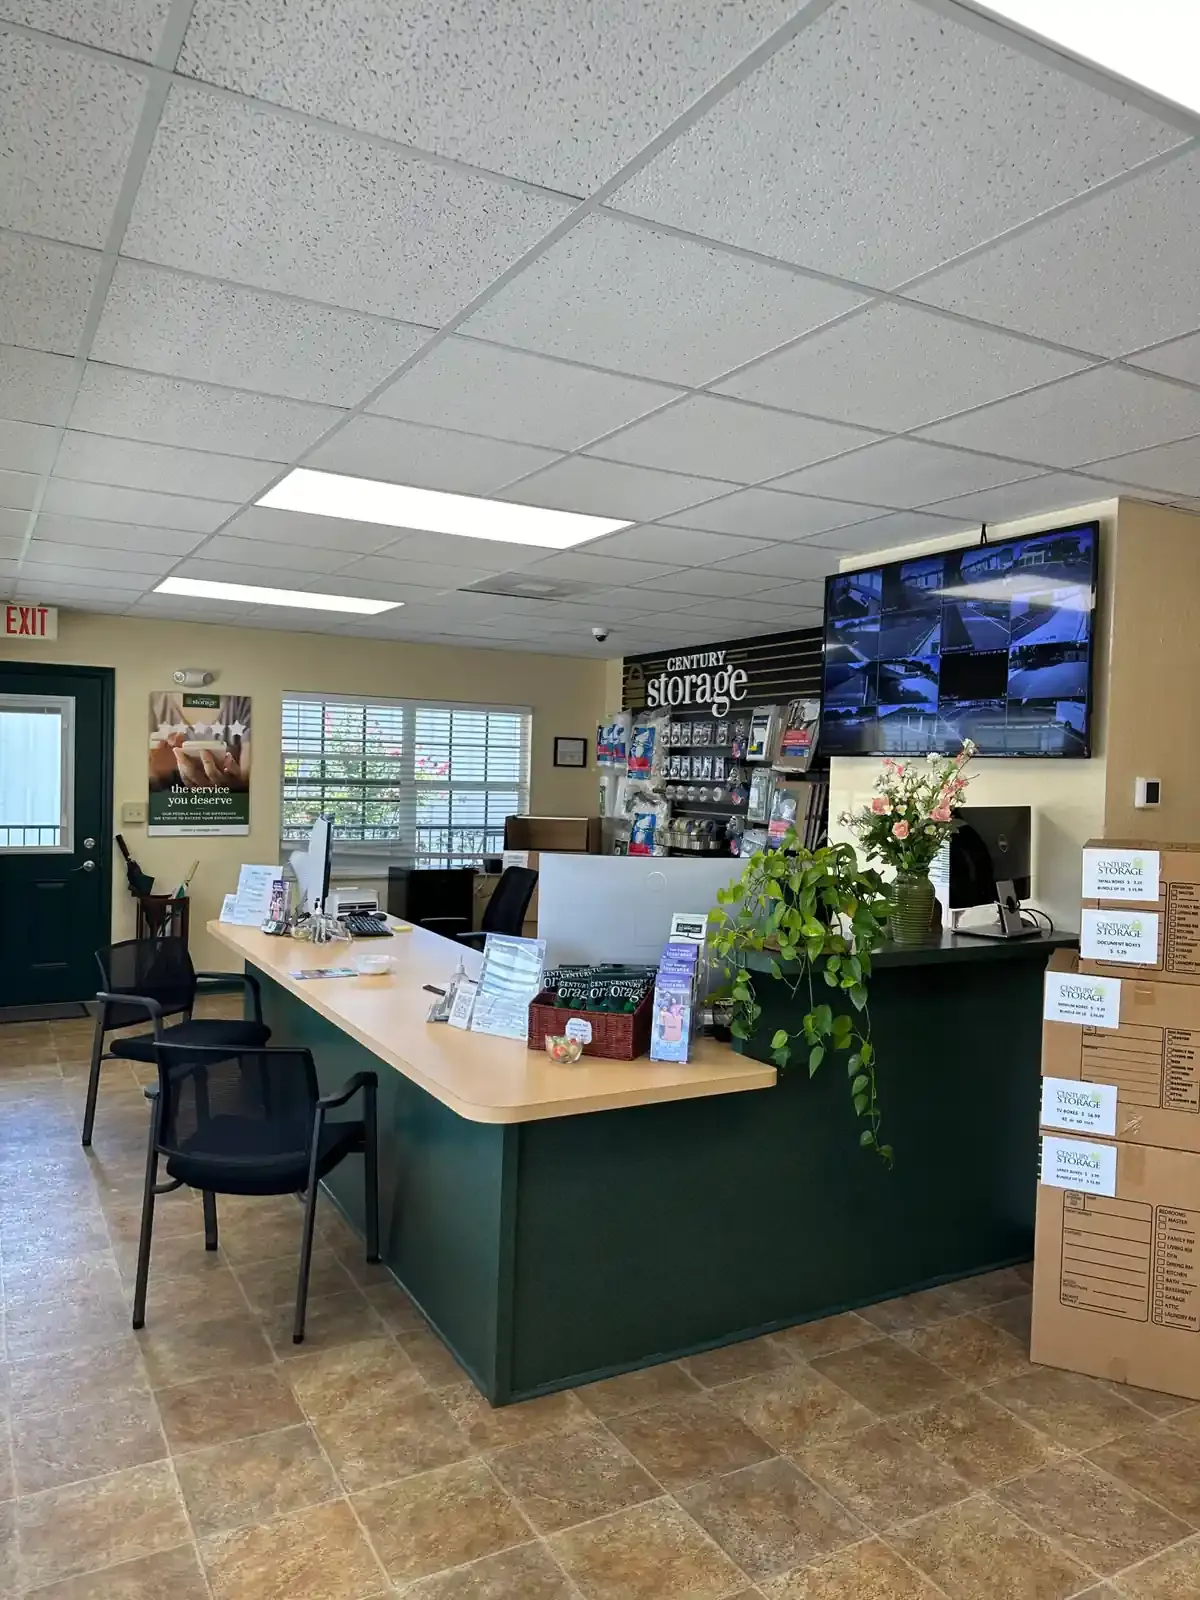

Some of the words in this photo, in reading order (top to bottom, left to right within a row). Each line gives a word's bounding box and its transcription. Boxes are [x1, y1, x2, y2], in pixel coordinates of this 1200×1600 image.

[6, 606, 49, 636] EXIT
[666, 650, 726, 672] CENTURY
[647, 664, 748, 718] storage
[171, 784, 189, 794] the
[191, 784, 230, 794] service
[168, 796, 188, 807] you
[190, 795, 233, 805] deserve
[1097, 861, 1131, 869] CENTURY
[1097, 867, 1143, 876] STORAGE
[1096, 921, 1131, 930] CENTURY
[1096, 927, 1142, 938] STORAGE
[1060, 984, 1094, 994] CENTURY
[1060, 990, 1105, 1002] STORAGE
[1056, 1090, 1090, 1101] CENTURY
[1056, 1096, 1101, 1109] STORAGE
[1056, 1149, 1090, 1161] CENTURY
[1056, 1155, 1101, 1169] STORAGE
[1159, 1208, 1187, 1218] BEDROOMS
[1168, 1217, 1188, 1225] MASTER
[1167, 1235, 1186, 1243] FAMILY
[1167, 1243, 1184, 1252] LIVING
[1167, 1251, 1178, 1260] DEN
[1166, 1260, 1184, 1269] DINING
[1166, 1269, 1188, 1278] KITCHEN
[1165, 1277, 1180, 1285] BATH
[1165, 1286, 1192, 1296] BASEMENT
[1165, 1294, 1186, 1303] GARAGE
[1165, 1302, 1180, 1311] ATTIC
[1164, 1311, 1188, 1321] LAUNDRY
